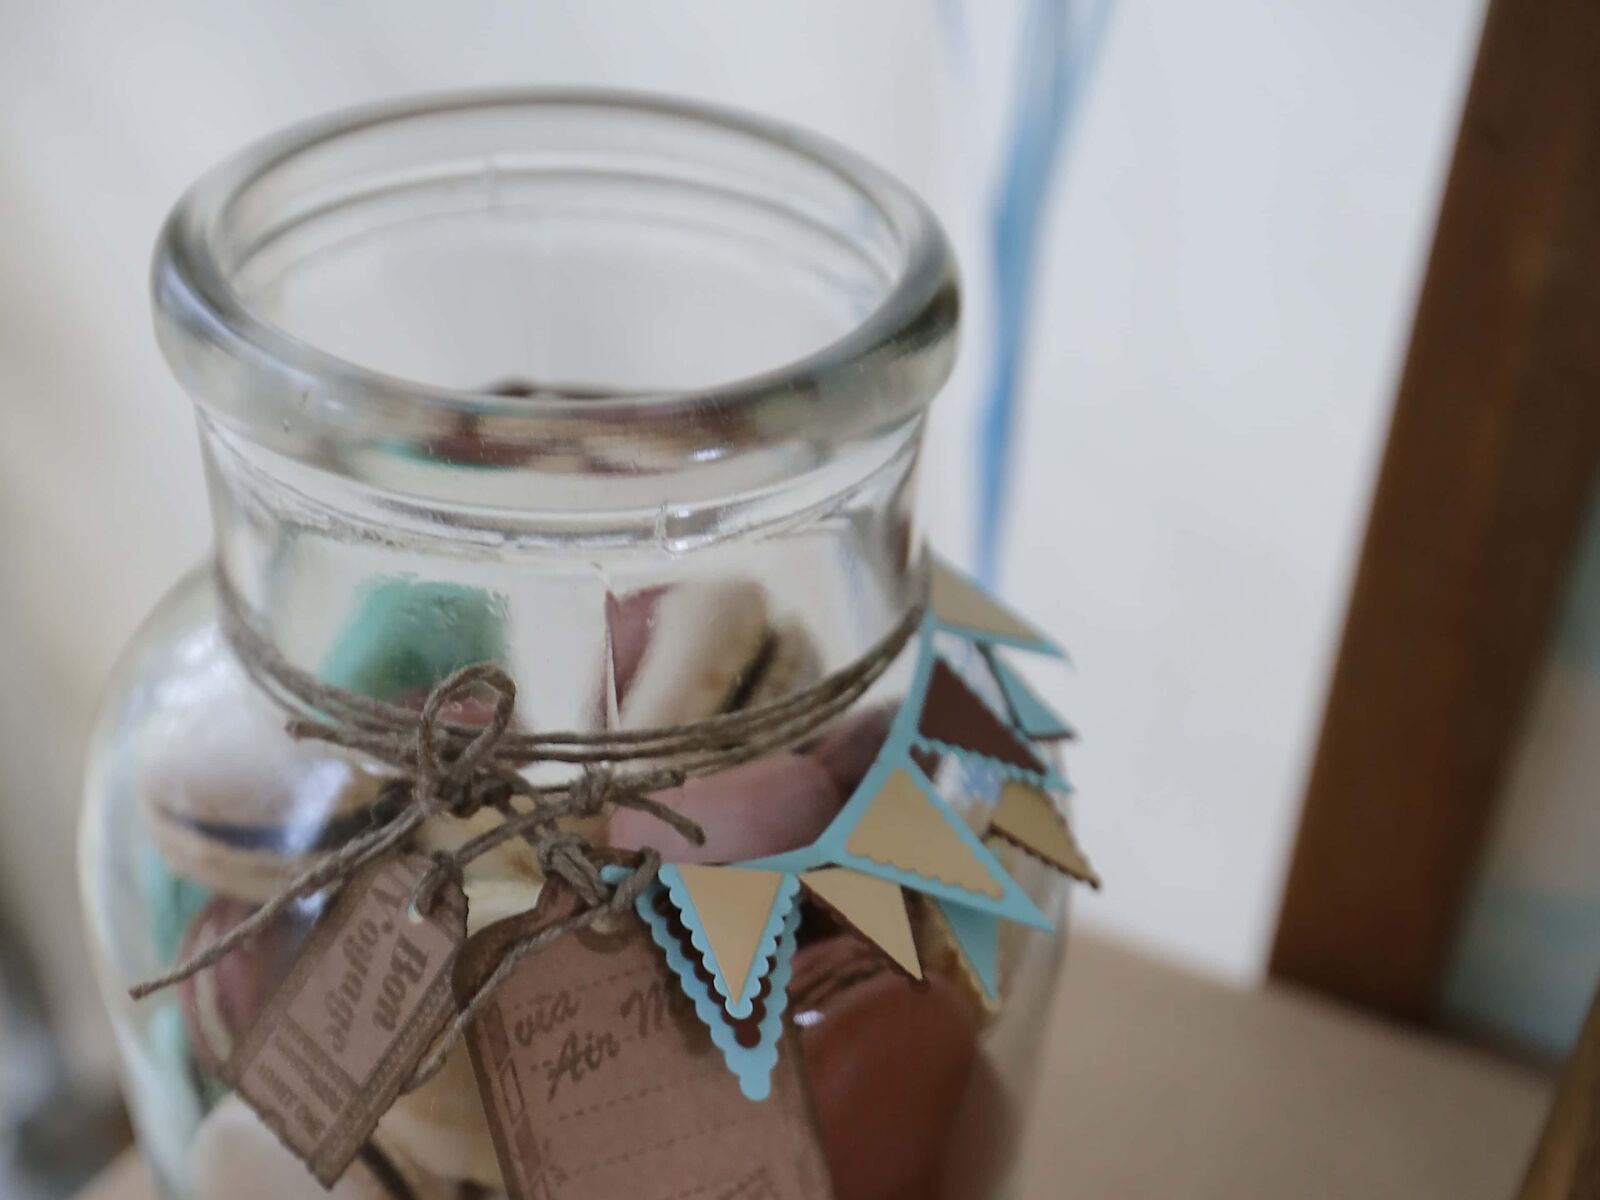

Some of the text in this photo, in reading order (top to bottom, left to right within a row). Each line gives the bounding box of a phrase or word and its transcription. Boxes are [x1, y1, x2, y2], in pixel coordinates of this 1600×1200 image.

[323, 886, 402, 1053] Voyage
[372, 934, 430, 1032] Bon
[547, 1030, 621, 1102] Air
